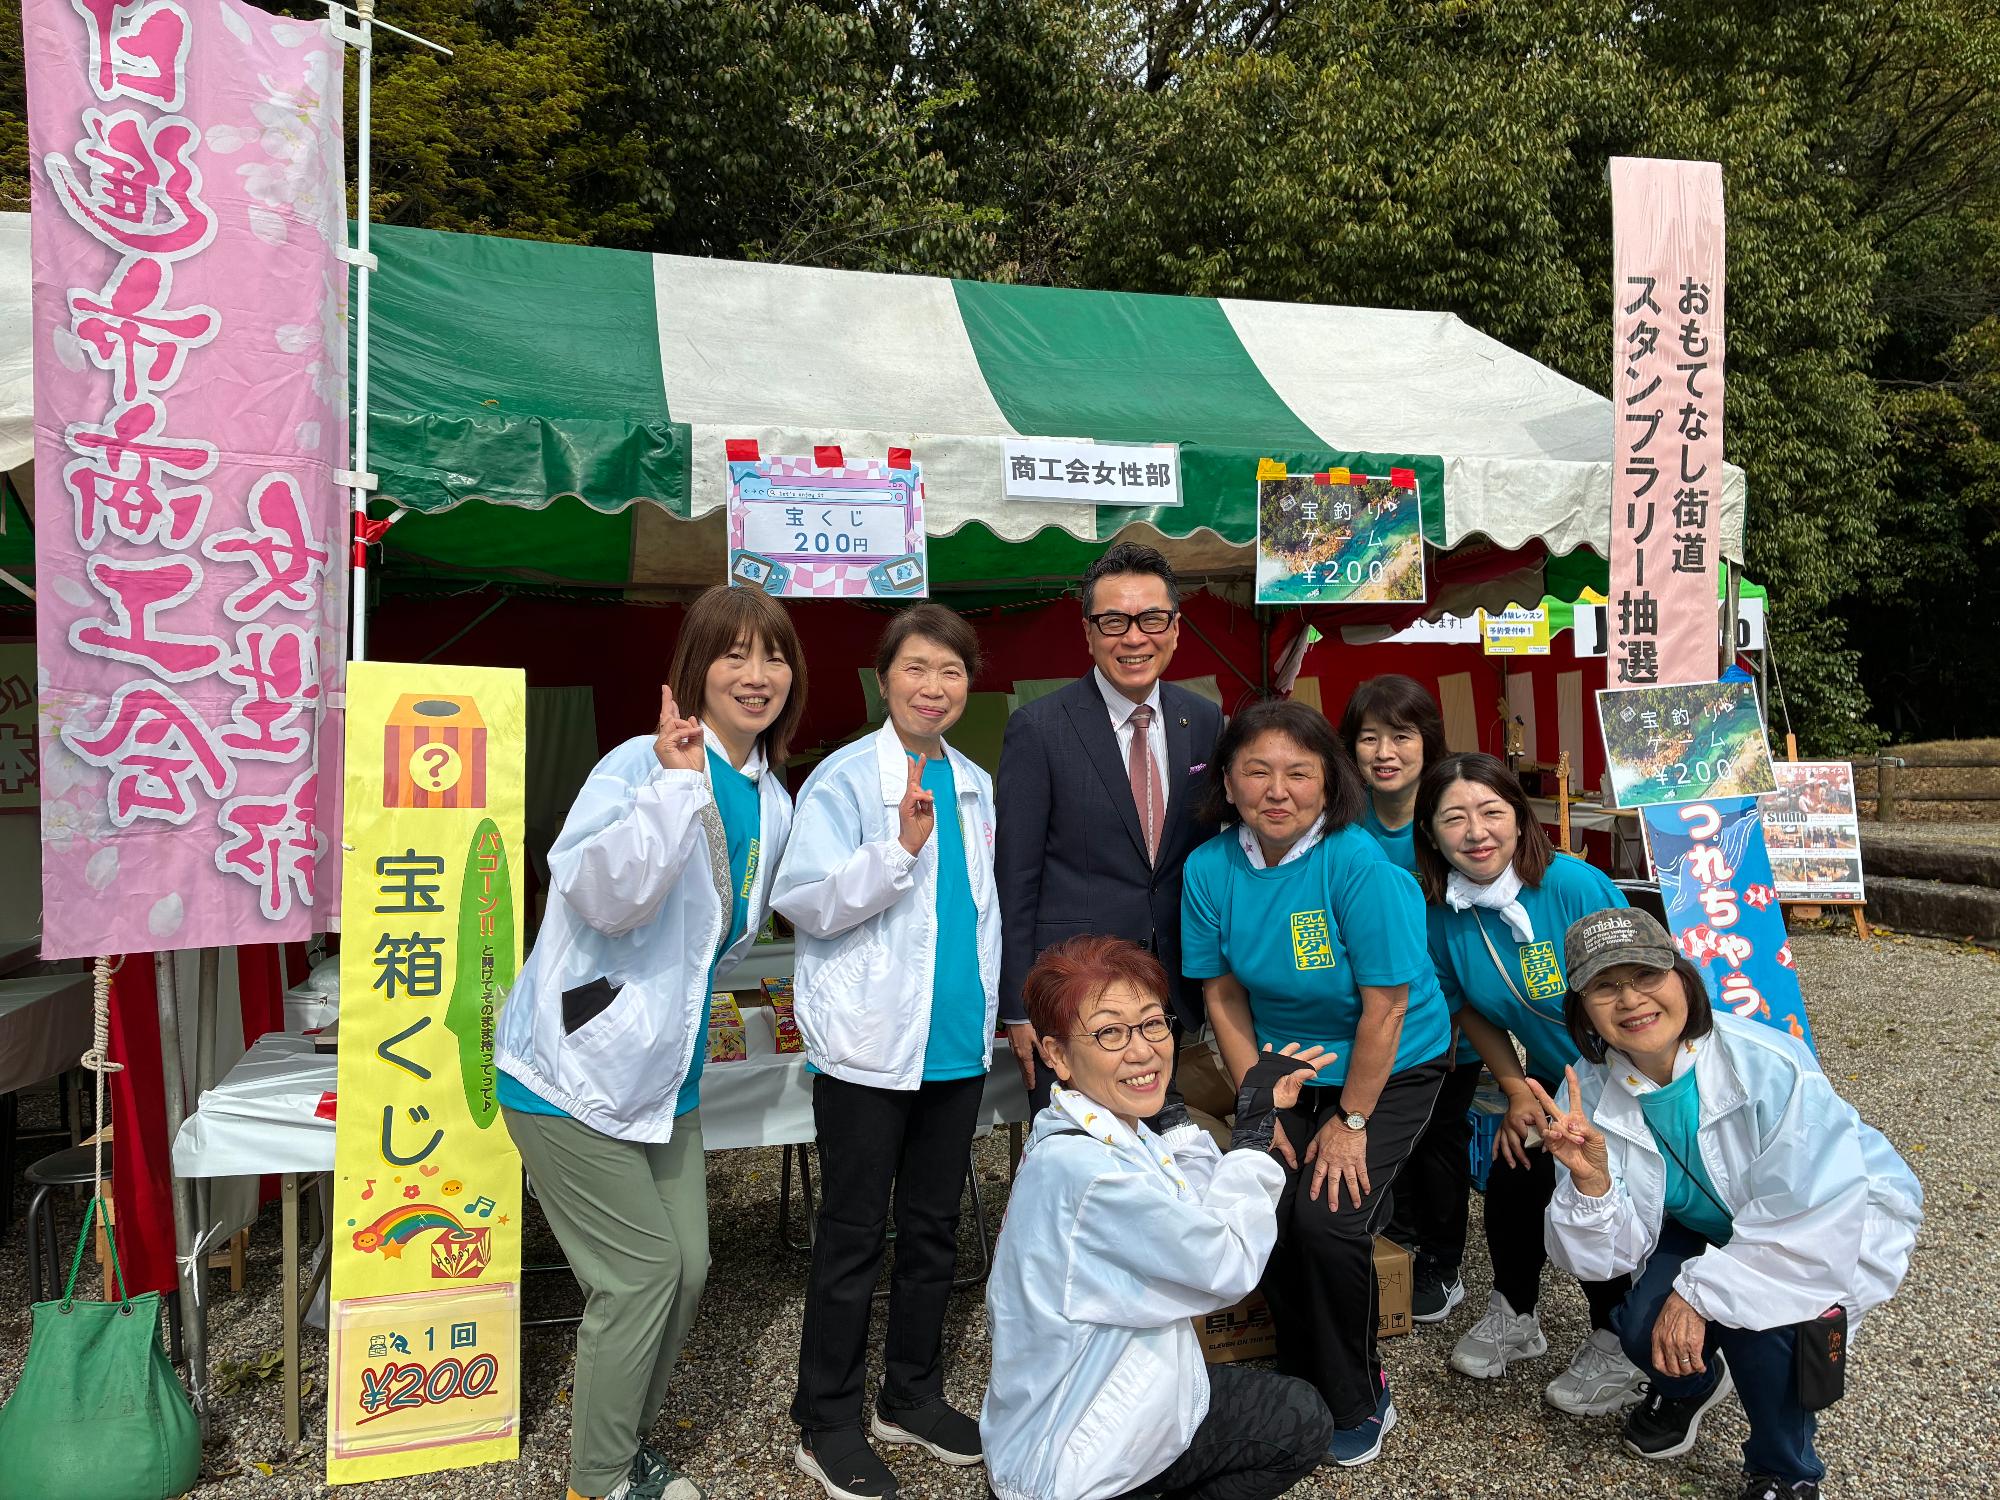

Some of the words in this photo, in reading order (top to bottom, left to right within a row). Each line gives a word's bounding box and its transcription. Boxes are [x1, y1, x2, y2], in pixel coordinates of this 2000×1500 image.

[1672, 276, 1710, 573] おもてなし街道
[1010, 455, 1171, 487] 商工会女性部
[1618, 276, 1663, 685] スタンプラリー抽選
[785, 507, 864, 527] 宝くじ
[1301, 501, 1381, 520] 宝釣り
[795, 533, 868, 553] 200円
[1302, 529, 1383, 547] ゲーム
[1302, 560, 1384, 584] ¥200
[1641, 706, 1719, 730] 宝釣り
[1647, 731, 1726, 753] ゲーム
[1655, 758, 1733, 786] ¥200
[1583, 917, 1632, 938] amiable
[1299, 953, 1330, 968] まつり
[1529, 982, 1561, 998] まつり
[374, 849, 446, 1166] 宝箱くじ
[436, 1247, 470, 1267] Happy
[424, 1321, 477, 1352] 1回
[359, 1352, 499, 1414] ¥200
